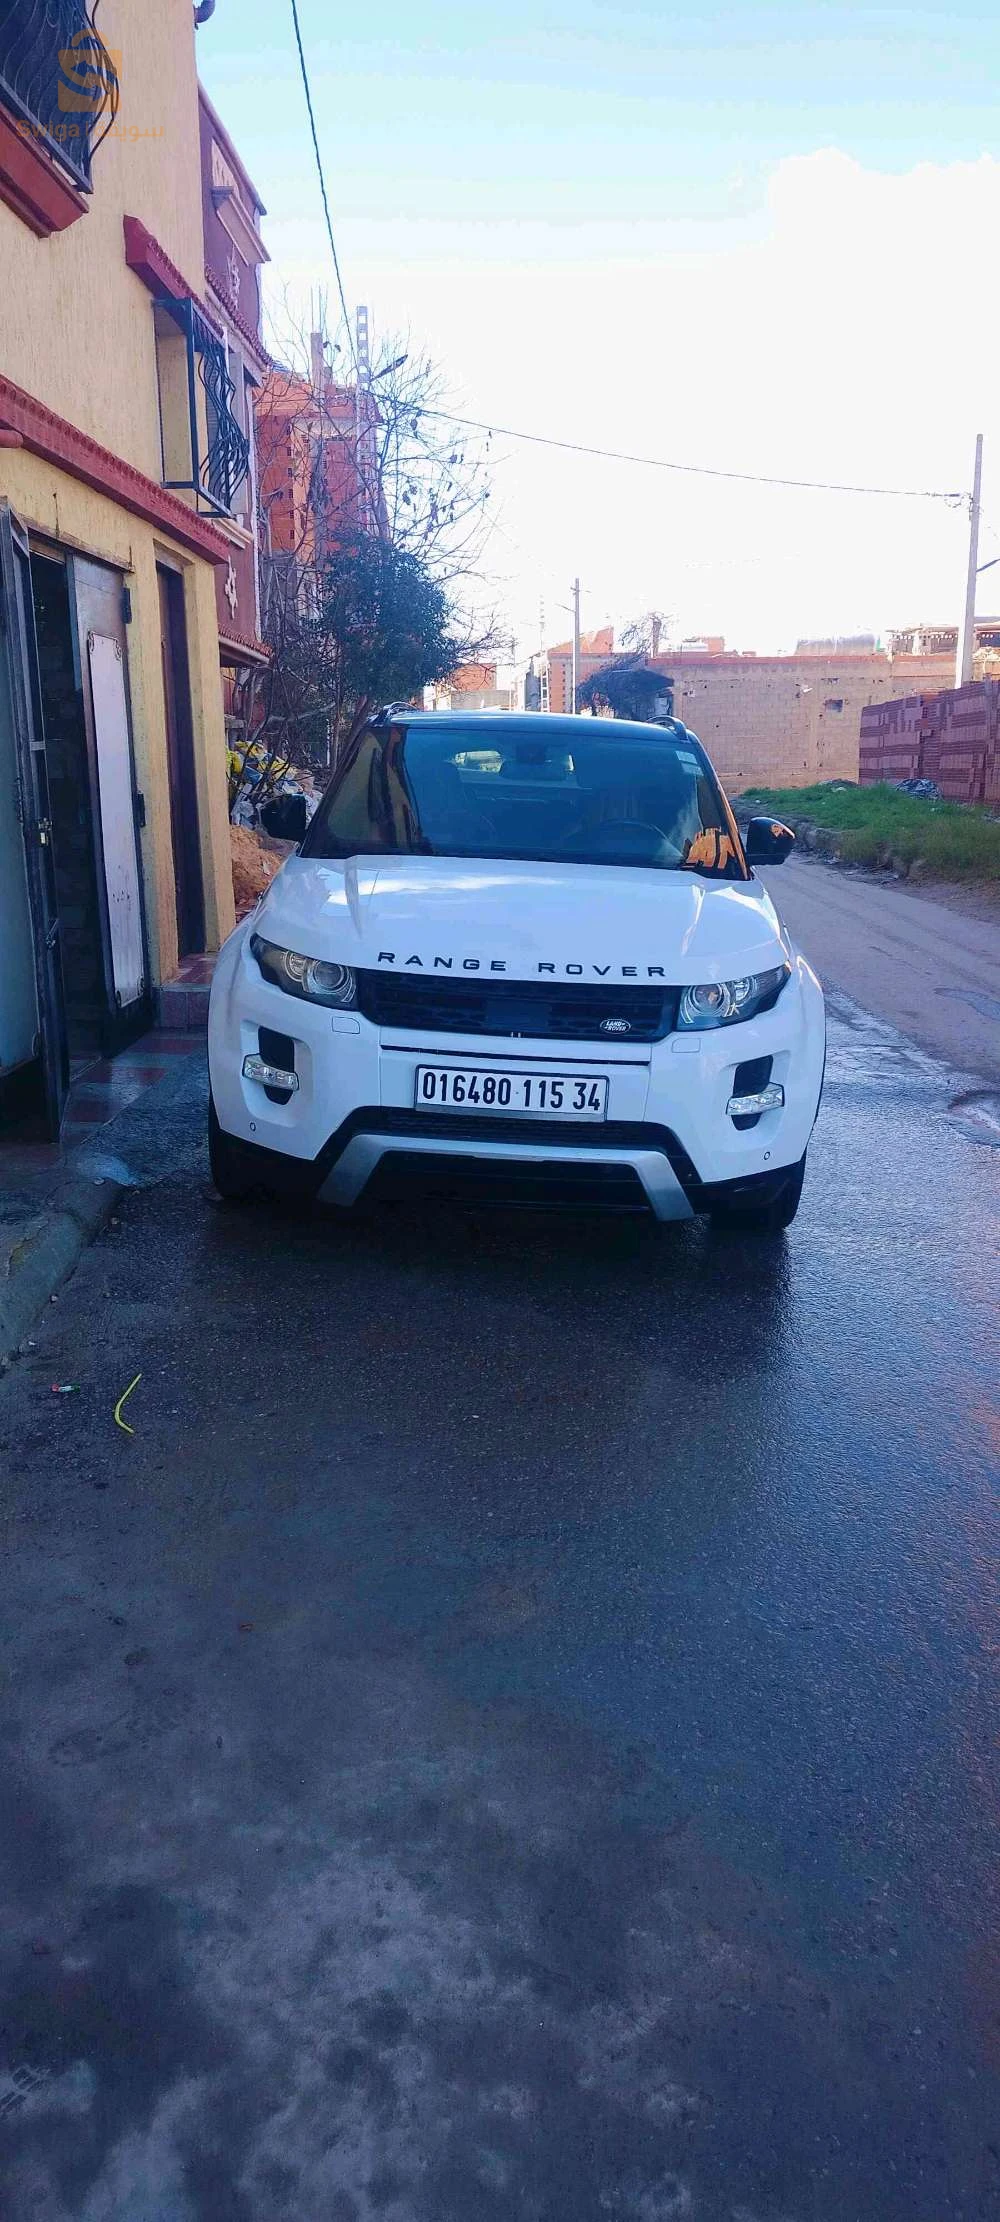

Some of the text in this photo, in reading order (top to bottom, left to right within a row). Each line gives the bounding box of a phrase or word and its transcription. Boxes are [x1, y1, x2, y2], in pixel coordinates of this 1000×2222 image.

[377, 951, 667, 978] RANGE ROVER
[422, 1071, 601, 1111] 016480 115 34
